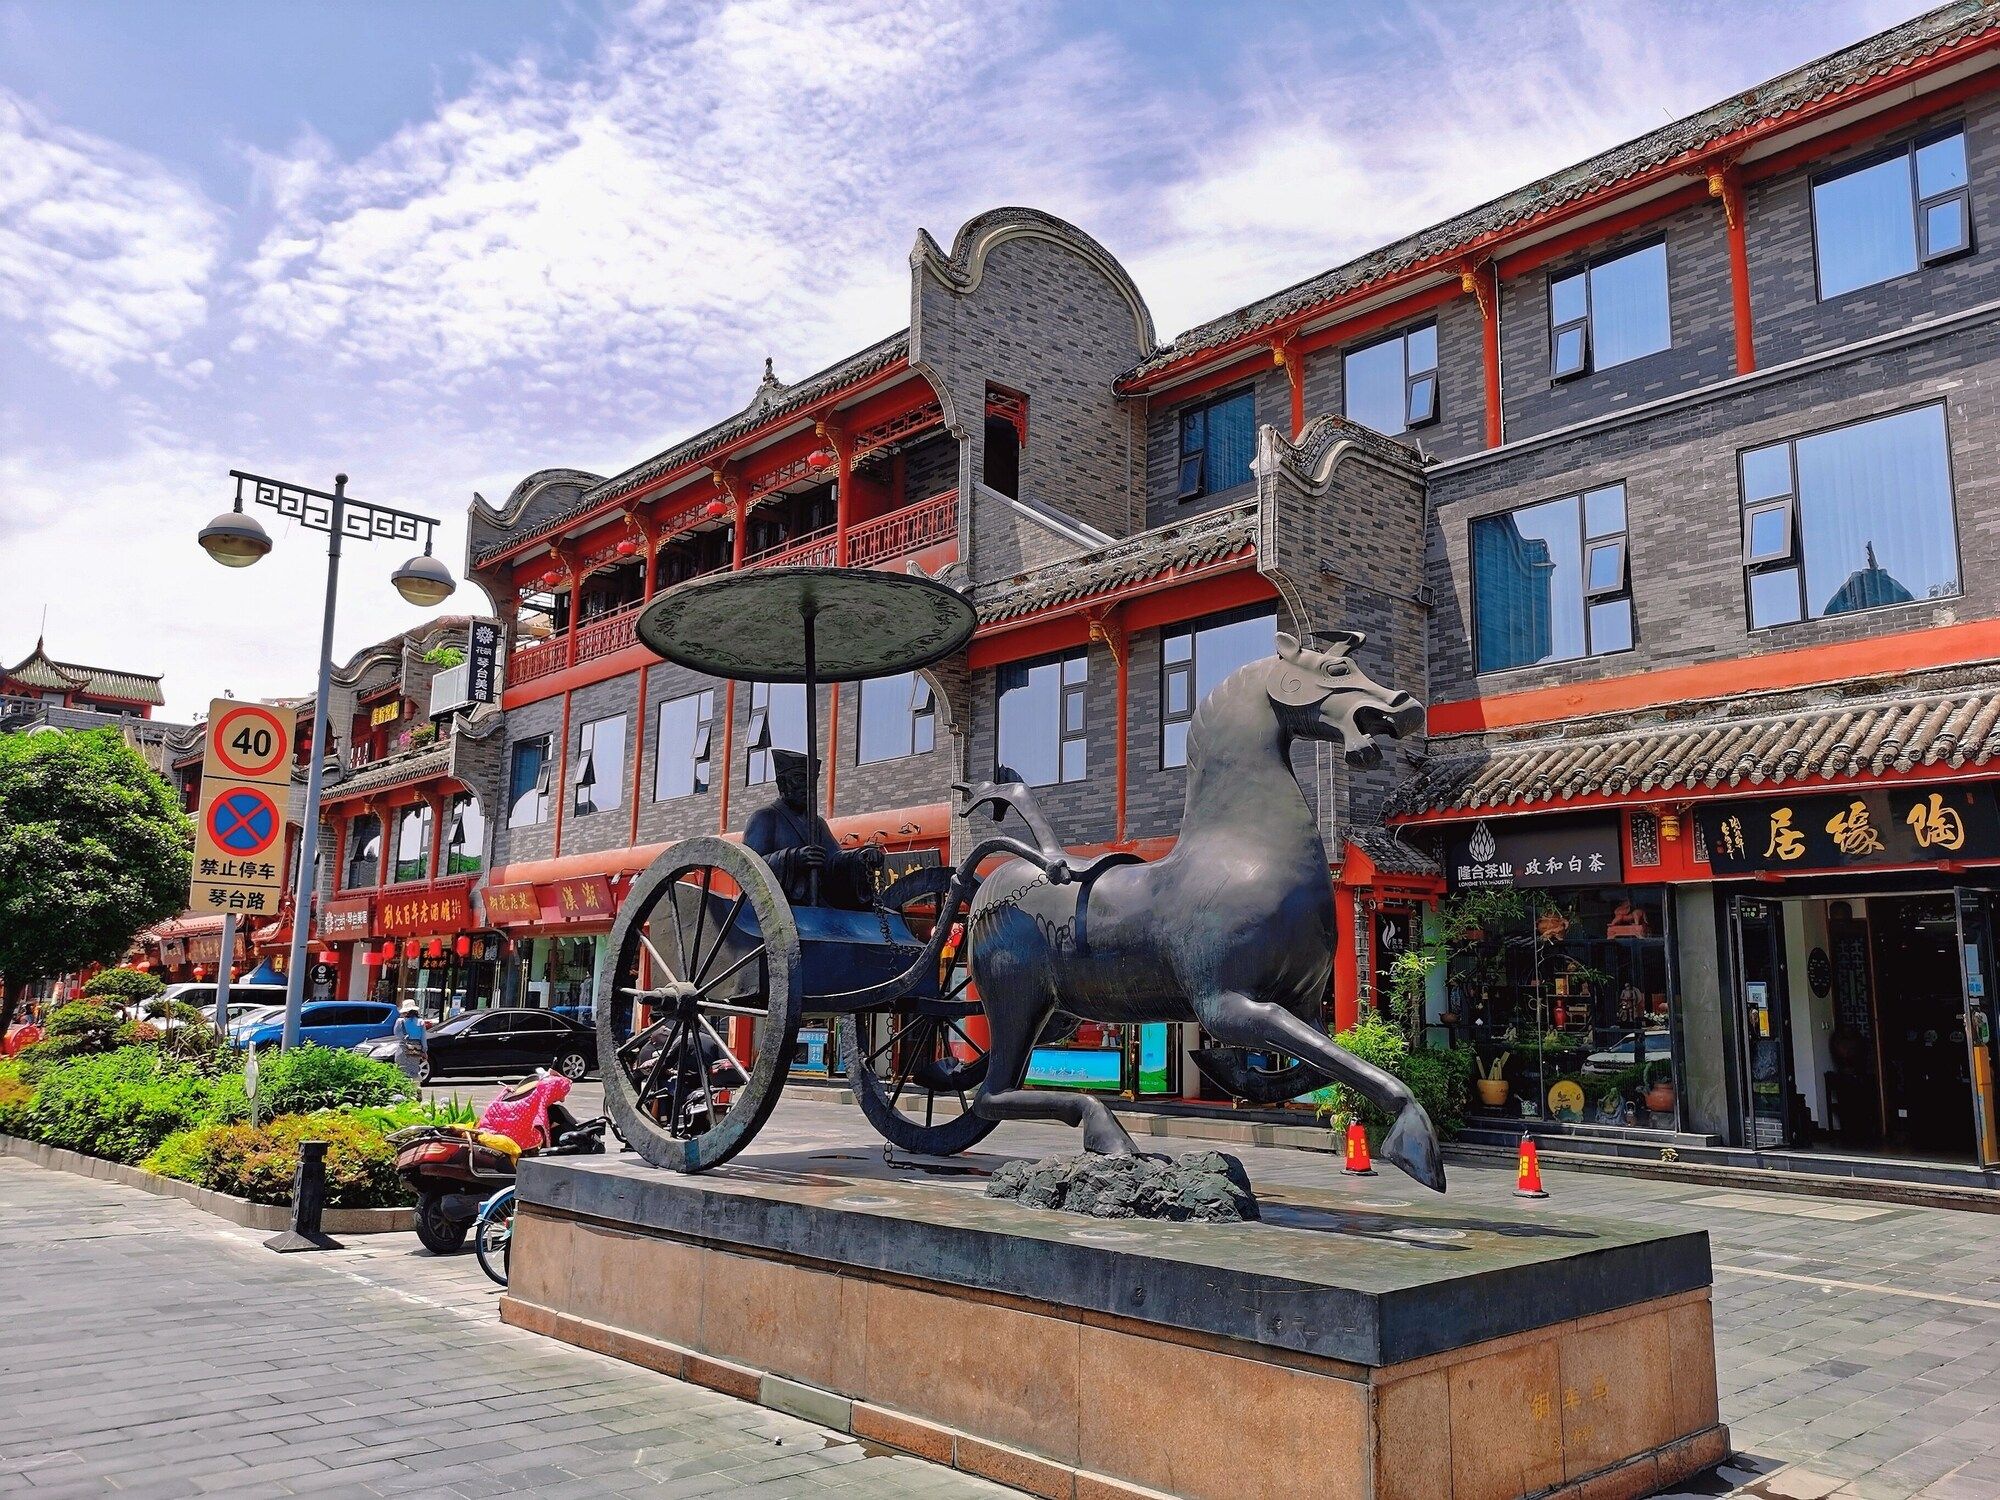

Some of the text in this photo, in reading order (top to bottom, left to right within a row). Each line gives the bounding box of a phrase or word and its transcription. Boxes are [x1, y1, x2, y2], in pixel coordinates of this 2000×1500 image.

[474, 656, 490, 701] 琴台美宿
[232, 727, 272, 757] 40
[200, 858, 276, 880] 禁止停车
[1457, 862, 1513, 881] 隆合茶业
[1524, 852, 1606, 876] 政和白茶
[207, 888, 266, 910] 琴台路
